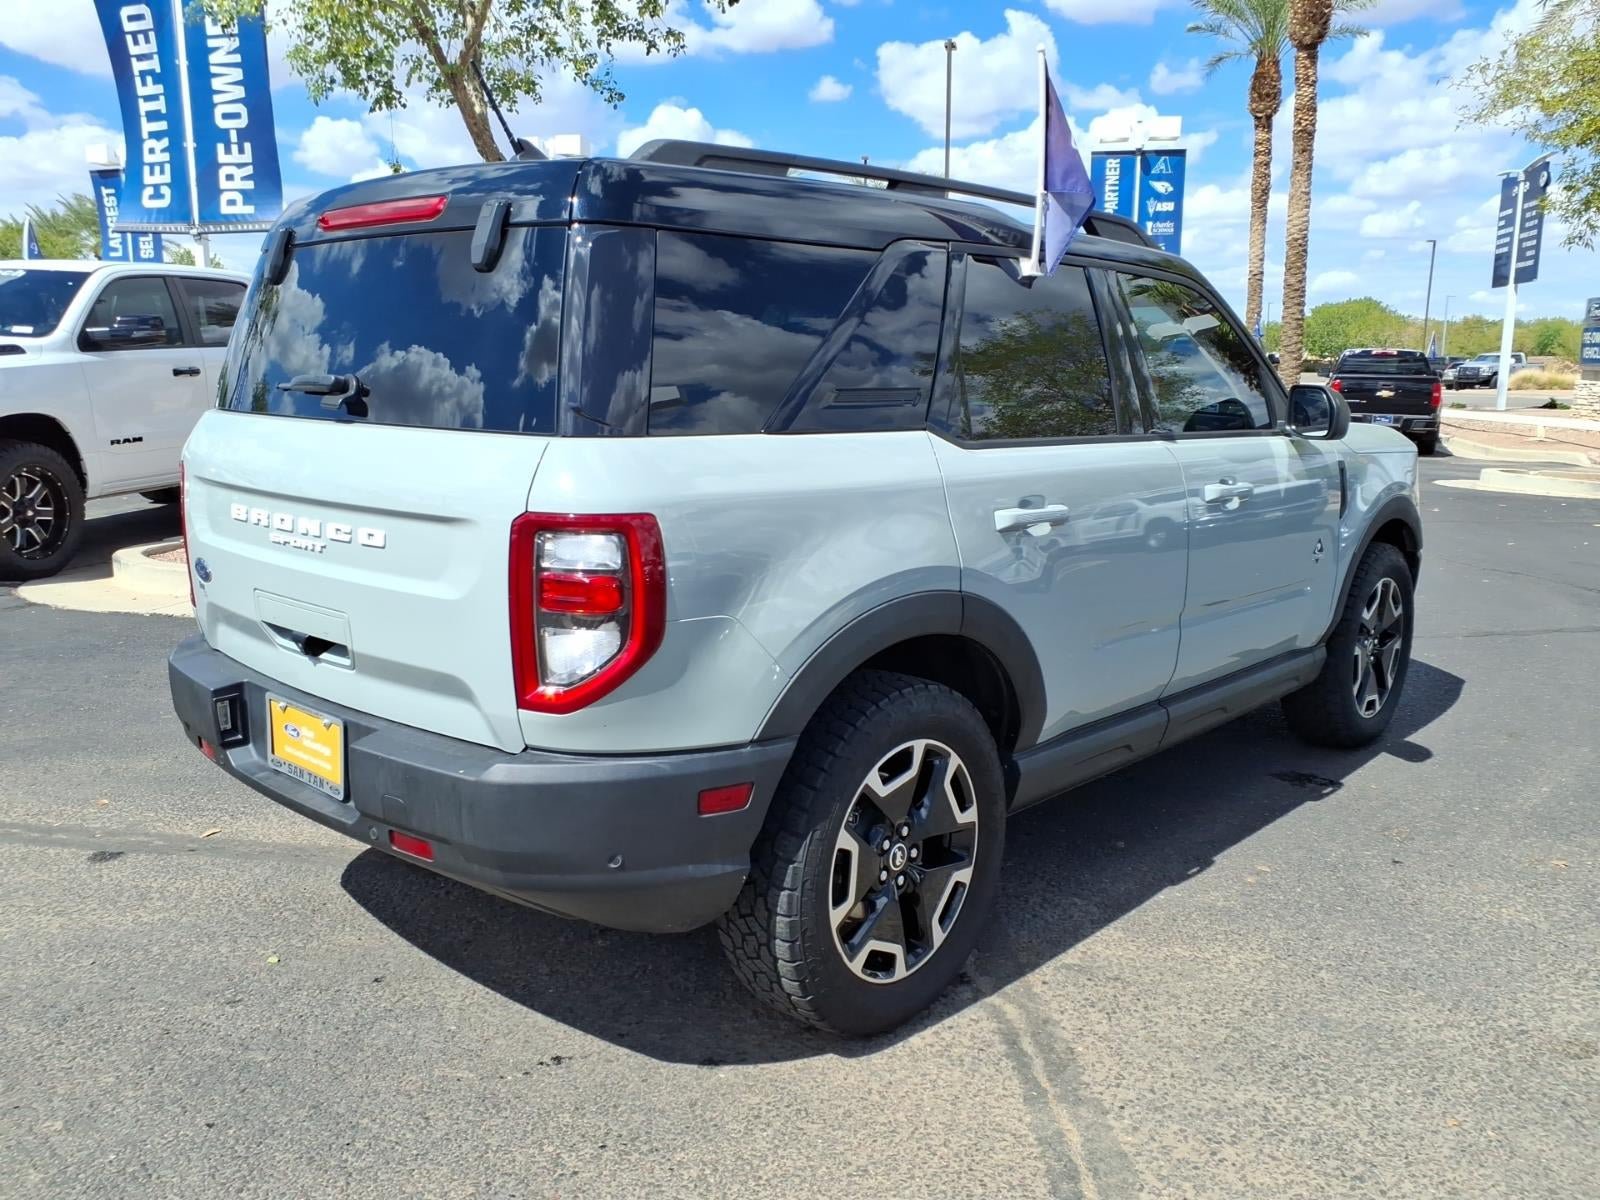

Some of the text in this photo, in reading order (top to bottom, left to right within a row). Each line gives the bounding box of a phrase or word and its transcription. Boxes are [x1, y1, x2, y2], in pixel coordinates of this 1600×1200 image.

[119, 3, 172, 209] CERTIFIED
[204, 10, 255, 215] PRE-OWNE
[110, 436, 143, 446] RAM
[230, 502, 387, 549] BRONCO
[269, 532, 328, 554] SPORT
